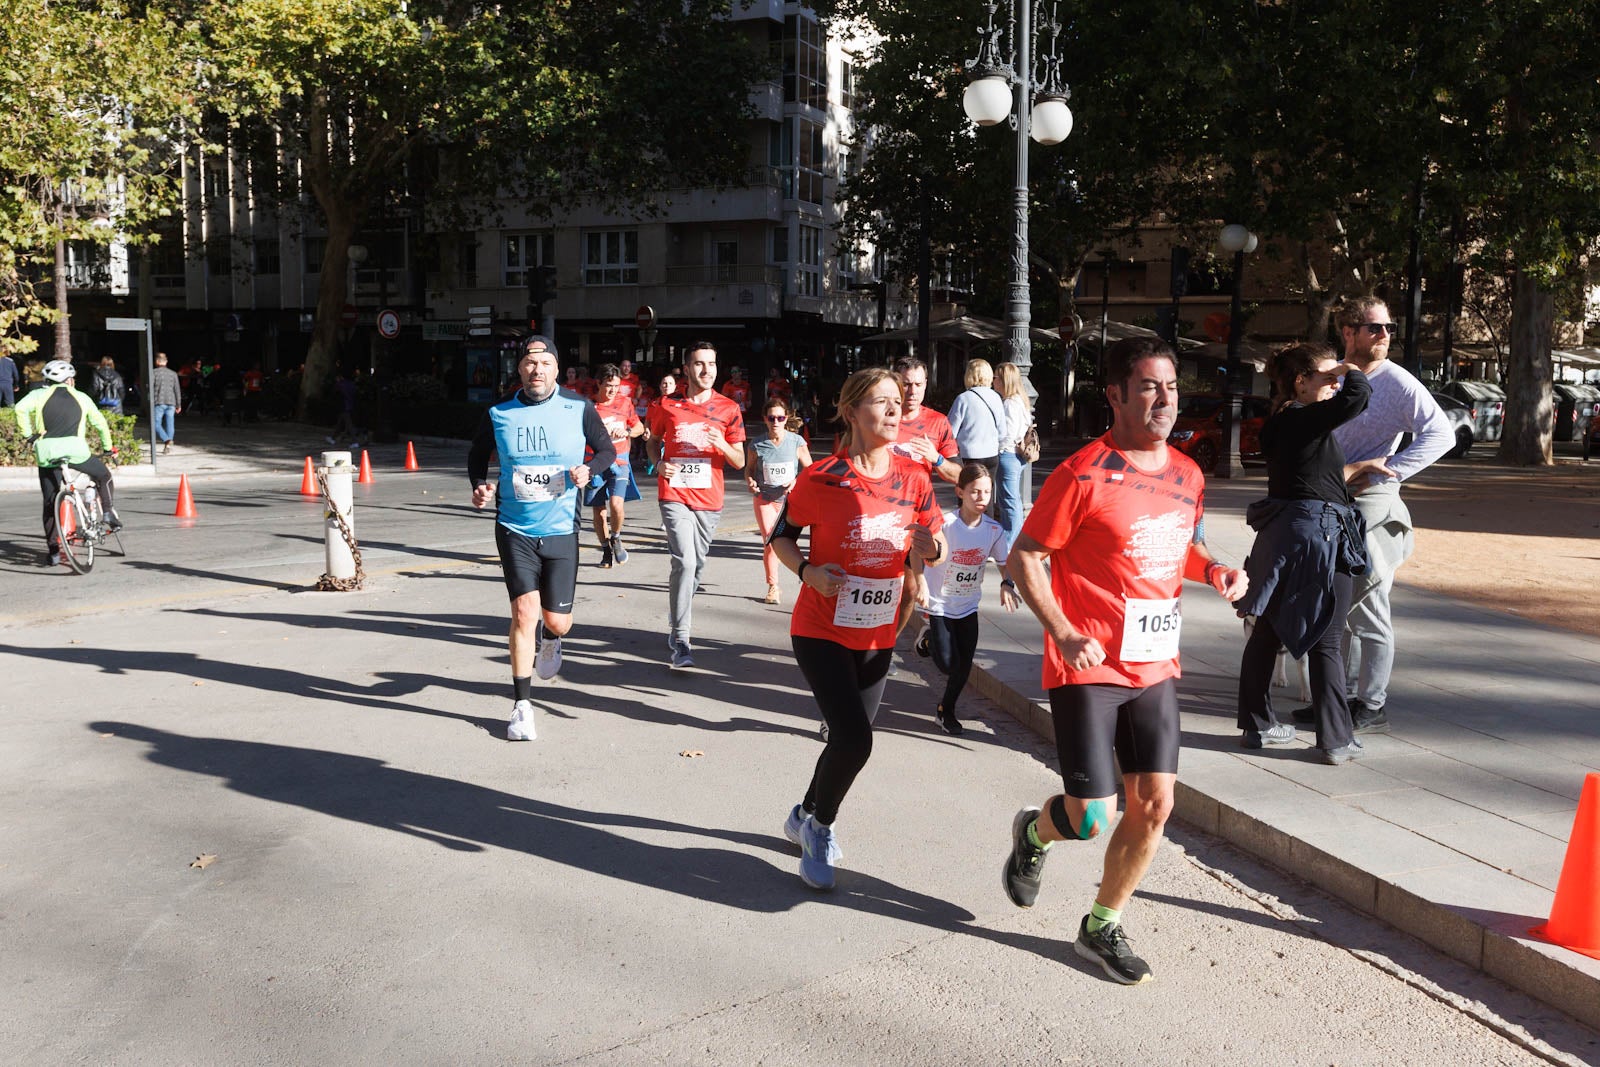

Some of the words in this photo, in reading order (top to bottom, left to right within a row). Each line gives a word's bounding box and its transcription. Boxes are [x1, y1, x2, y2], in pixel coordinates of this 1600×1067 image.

[517, 425, 549, 453] ENA
[680, 464, 701, 474] 235
[769, 467, 786, 475] 790
[524, 473, 550, 485] 649
[956, 571, 978, 583] 644
[850, 588, 893, 605] 1688
[1138, 613, 1178, 633] 1053
